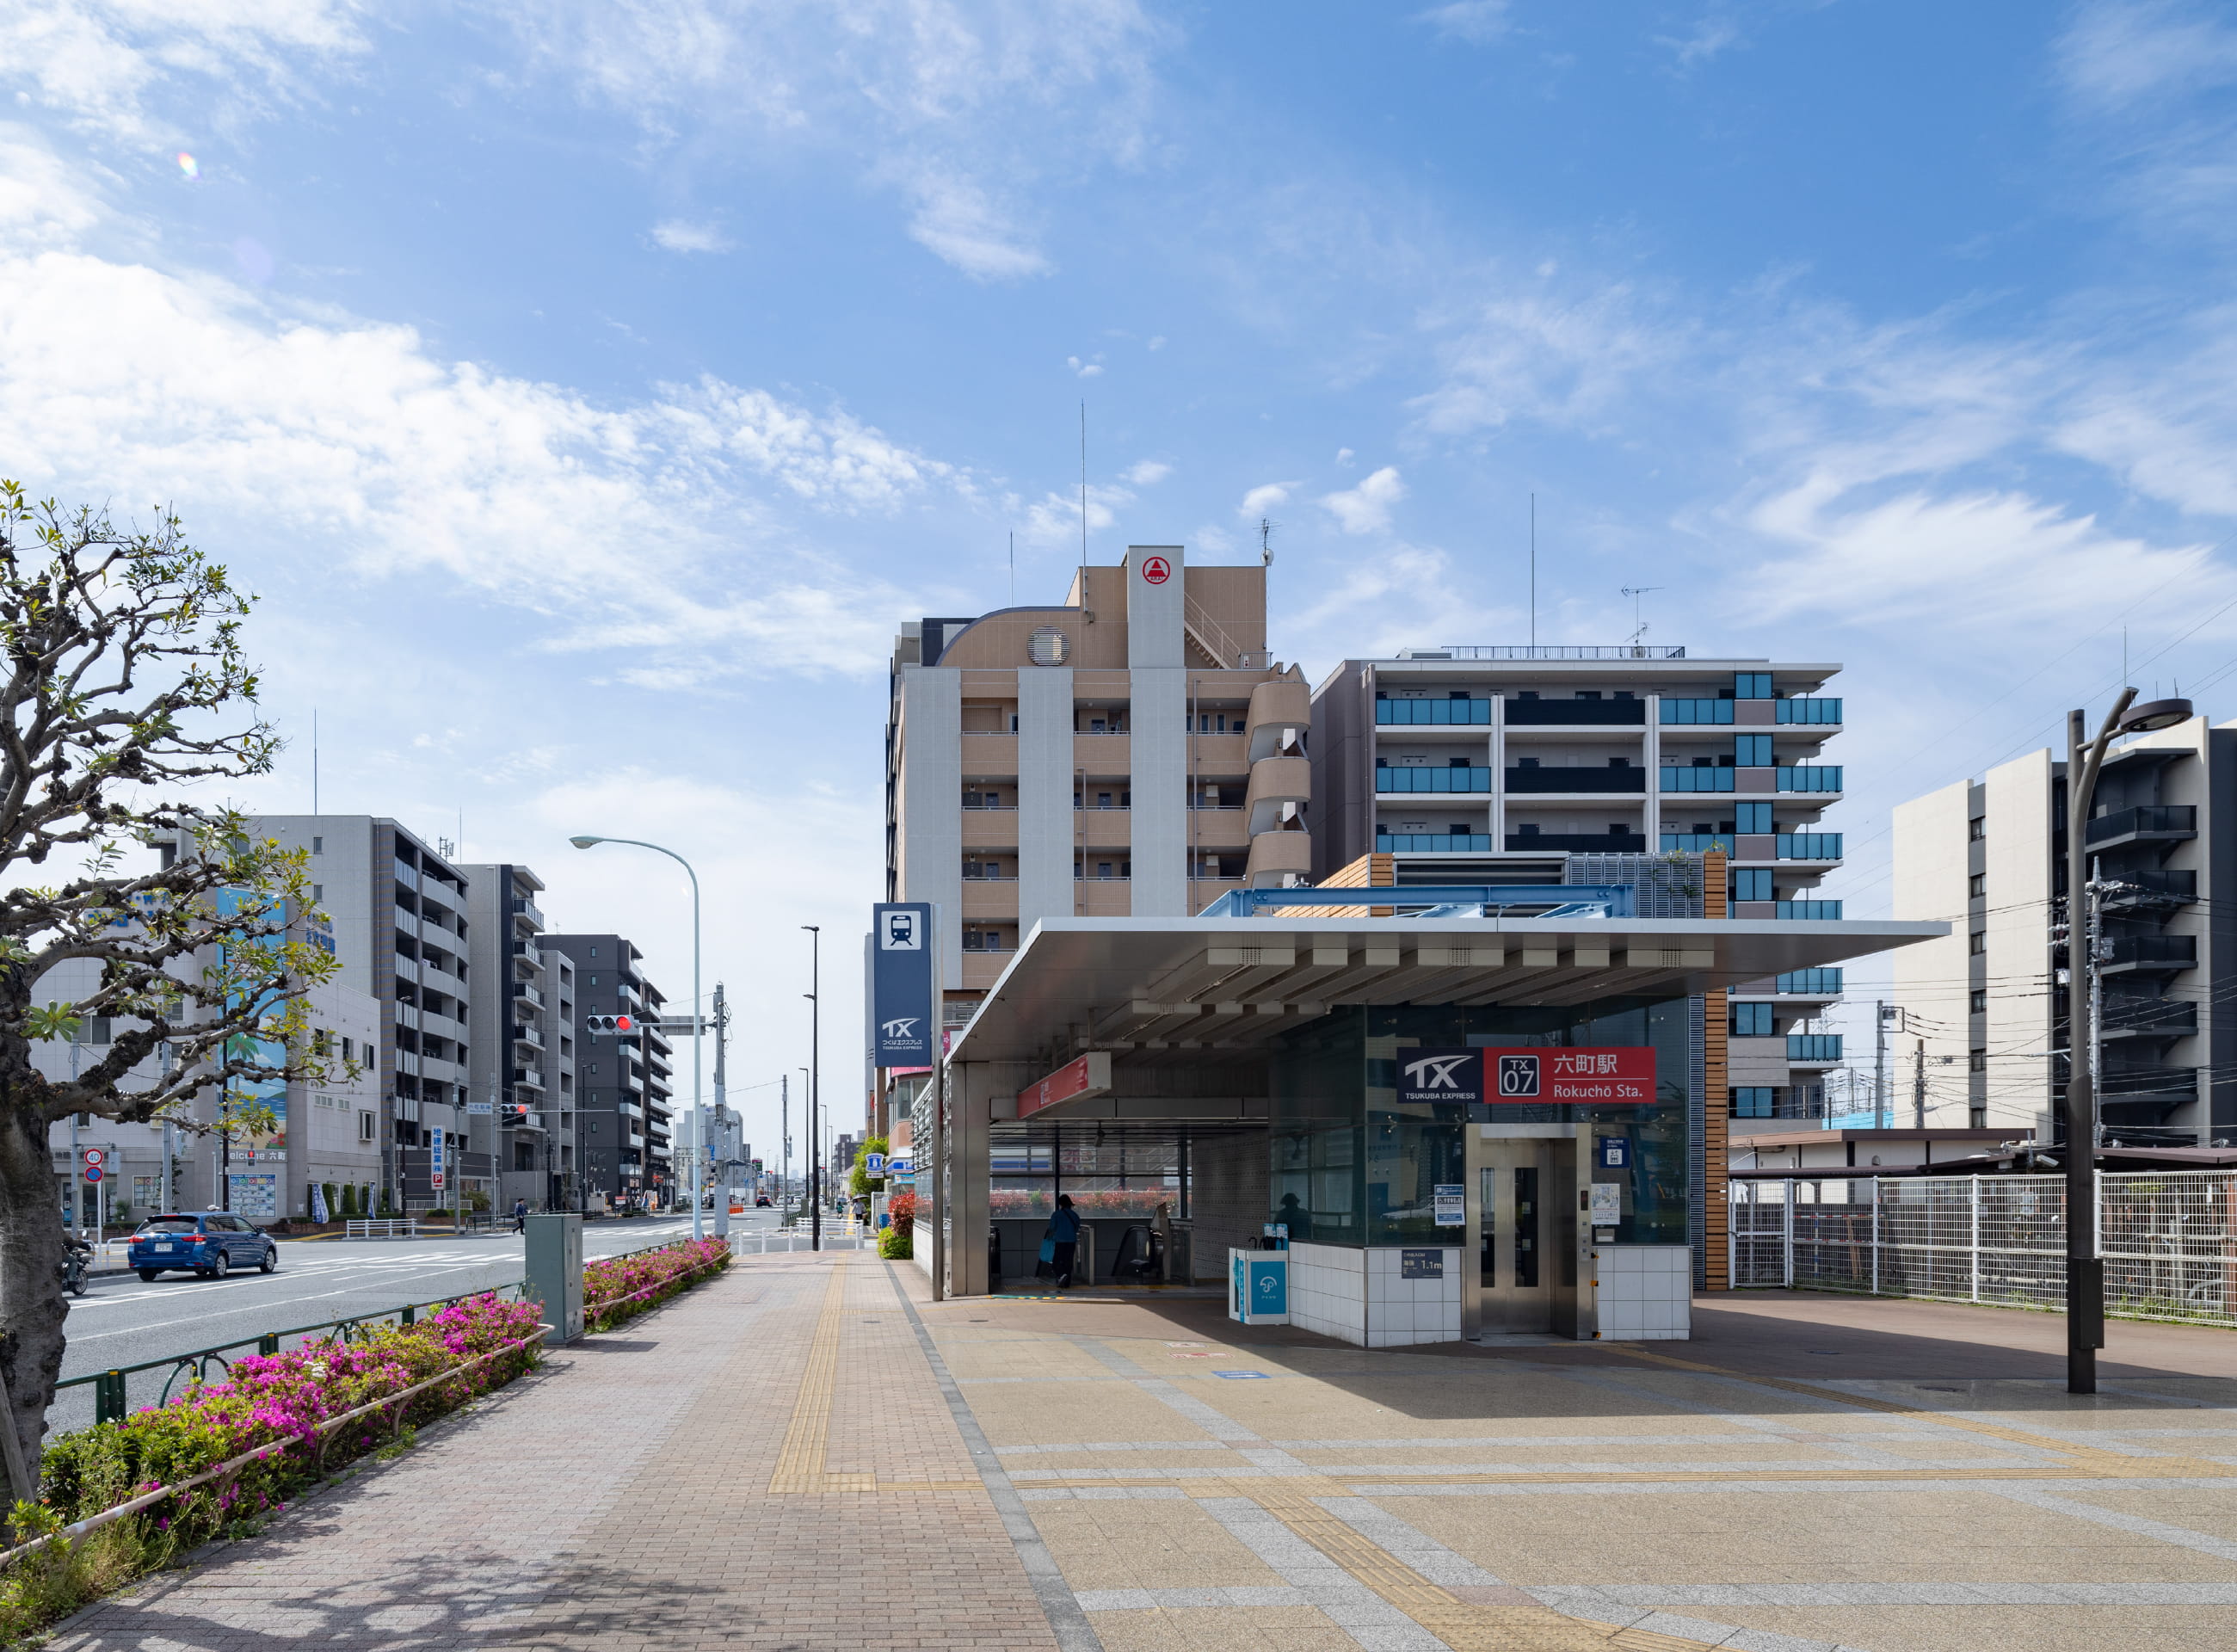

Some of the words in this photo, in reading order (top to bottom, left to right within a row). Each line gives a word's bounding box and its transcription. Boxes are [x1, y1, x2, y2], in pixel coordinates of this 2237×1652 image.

[882, 1018, 921, 1037] TX
[1510, 1060, 1528, 1069] TX
[1554, 1054, 1618, 1075] 六町駅
[1405, 1055, 1475, 1088] TX
[1503, 1070, 1535, 1093] 07
[1554, 1084, 1612, 1098] Rokuchō
[1617, 1084, 1643, 1098] Sta.
[89, 1153, 100, 1162] 40
[269, 1151, 286, 1160] 六町
[434, 1174, 441, 1183] P
[1421, 1260, 1442, 1269] 1.1m
